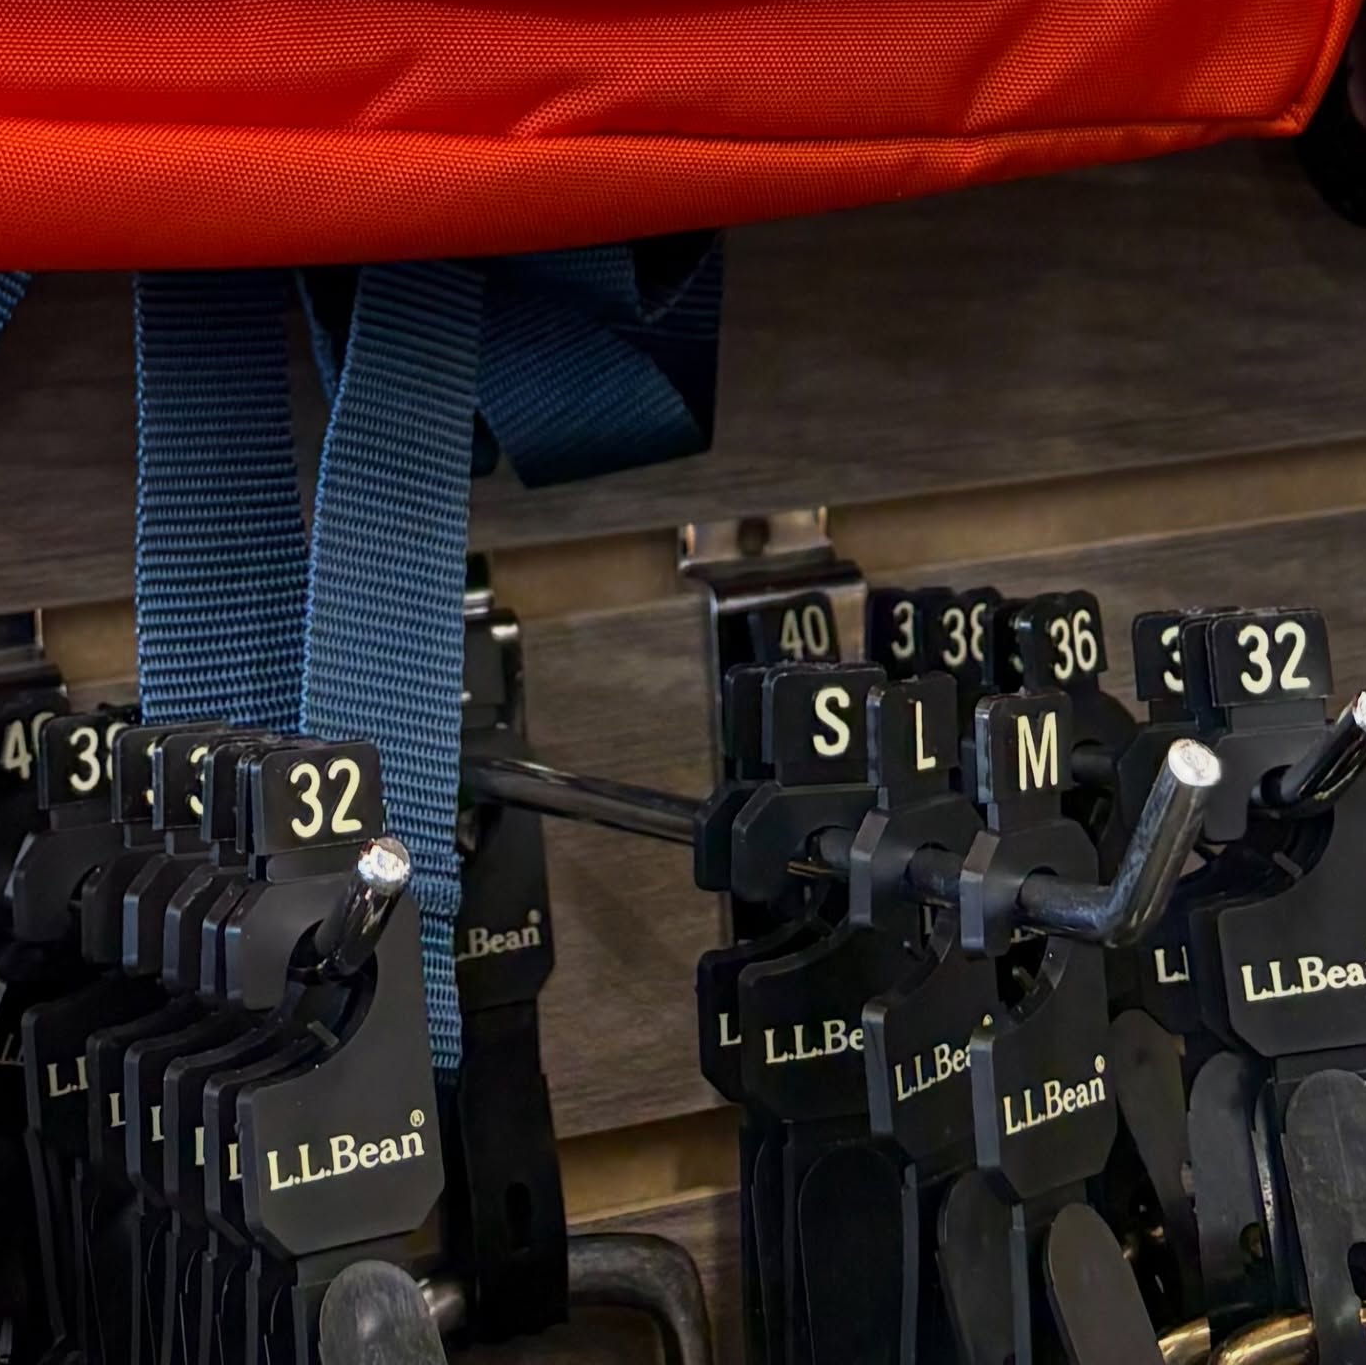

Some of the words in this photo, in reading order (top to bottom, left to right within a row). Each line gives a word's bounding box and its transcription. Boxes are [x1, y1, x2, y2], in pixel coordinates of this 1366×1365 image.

[780, 606, 829, 662] 40
[1050, 609, 1098, 680] 36
[1238, 622, 1311, 694] 32
[812, 687, 851, 757] S
[916, 701, 936, 771] L
[1017, 712, 1058, 791] M
[290, 758, 363, 839] 32
[765, 1020, 865, 1065] L.L.Be
[1003, 1073, 1106, 1136] L.L.Bean
[268, 1131, 425, 1191] L.L.Bean
